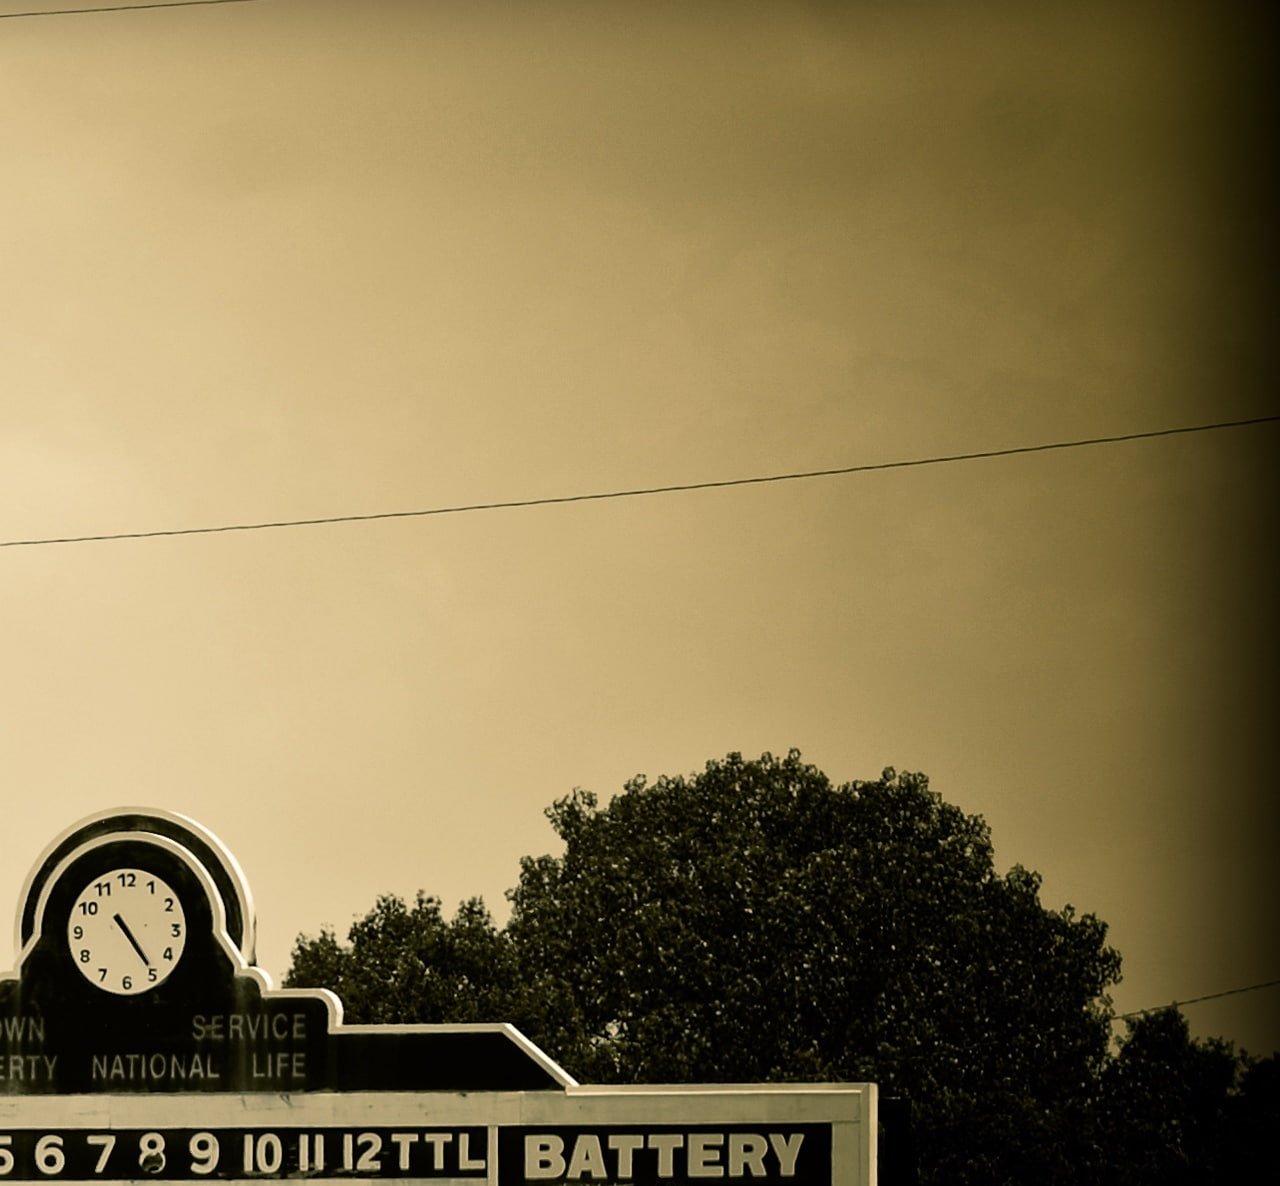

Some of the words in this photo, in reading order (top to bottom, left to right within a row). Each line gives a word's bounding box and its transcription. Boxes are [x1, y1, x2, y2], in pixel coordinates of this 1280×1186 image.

[117, 872, 137, 888] 12
[146, 880, 155, 895] 1
[93, 881, 111, 897] 11
[78, 901, 99, 916] 10
[164, 897, 174, 912] 2
[73, 925, 84, 940] 9
[171, 923, 181, 938] 3
[79, 949, 91, 964] 8
[162, 946, 173, 962] 4
[98, 968, 108, 982] 7
[122, 975, 133, 991] 6
[148, 967, 158, 983] 5
[191, 1013, 307, 1042] SERVICE
[92, 1053, 220, 1080] NATIONAL
[252, 1052, 307, 1079] LIFE
[34, 1134, 66, 1175] 6
[86, 1134, 116, 1173] 7
[138, 1132, 167, 1174] 8
[189, 1132, 220, 1175] 9
[243, 1133, 283, 1174] 10
[299, 1133, 325, 1172] 11
[343, 1132, 383, 1171] 12
[390, 1132, 486, 1171] TTL
[524, 1133, 805, 1180] BATTERY
